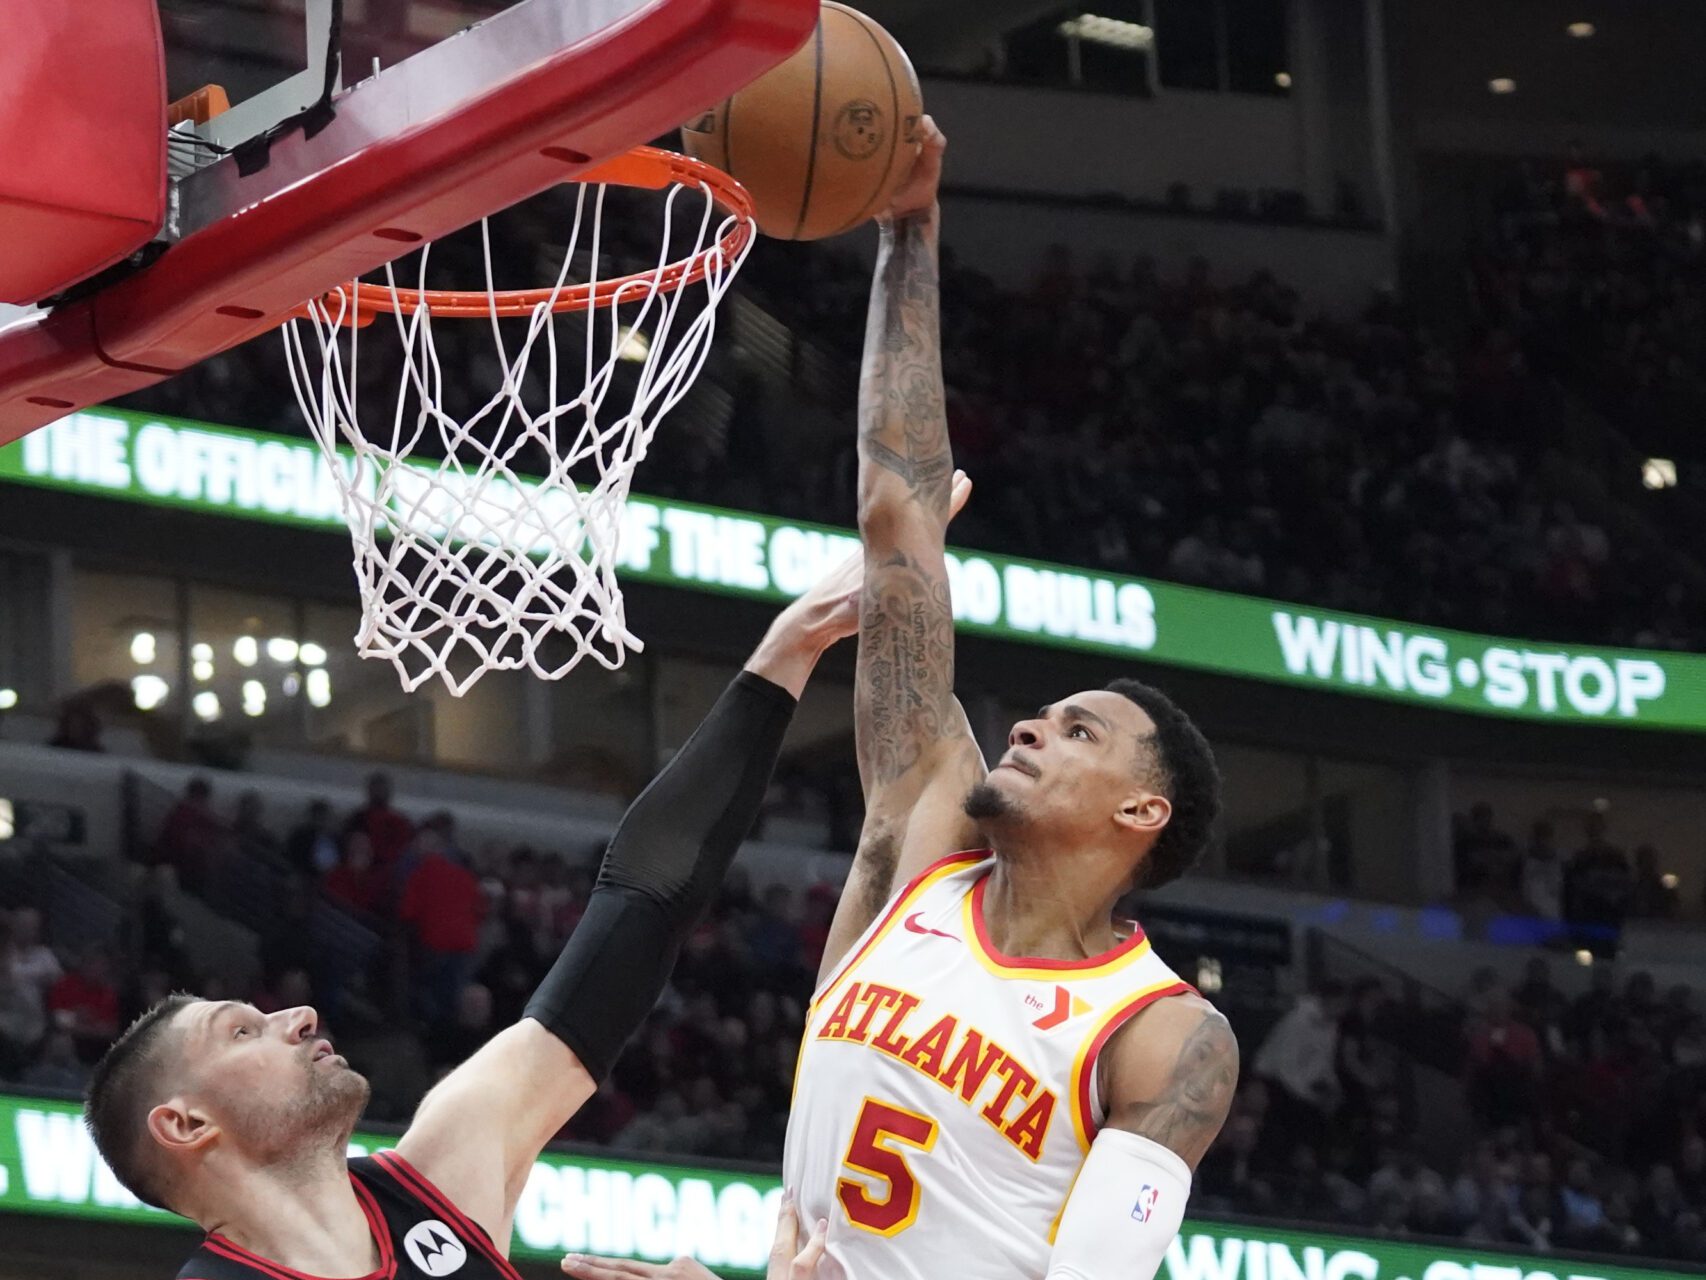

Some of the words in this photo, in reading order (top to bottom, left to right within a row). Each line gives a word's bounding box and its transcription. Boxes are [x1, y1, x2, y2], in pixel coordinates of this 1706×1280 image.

[662, 507, 769, 592] THE
[1003, 564, 1157, 650] BULLS
[814, 981, 1060, 1165] ATLANTA
[1024, 993, 1044, 1011] the
[835, 1095, 939, 1240] 5
